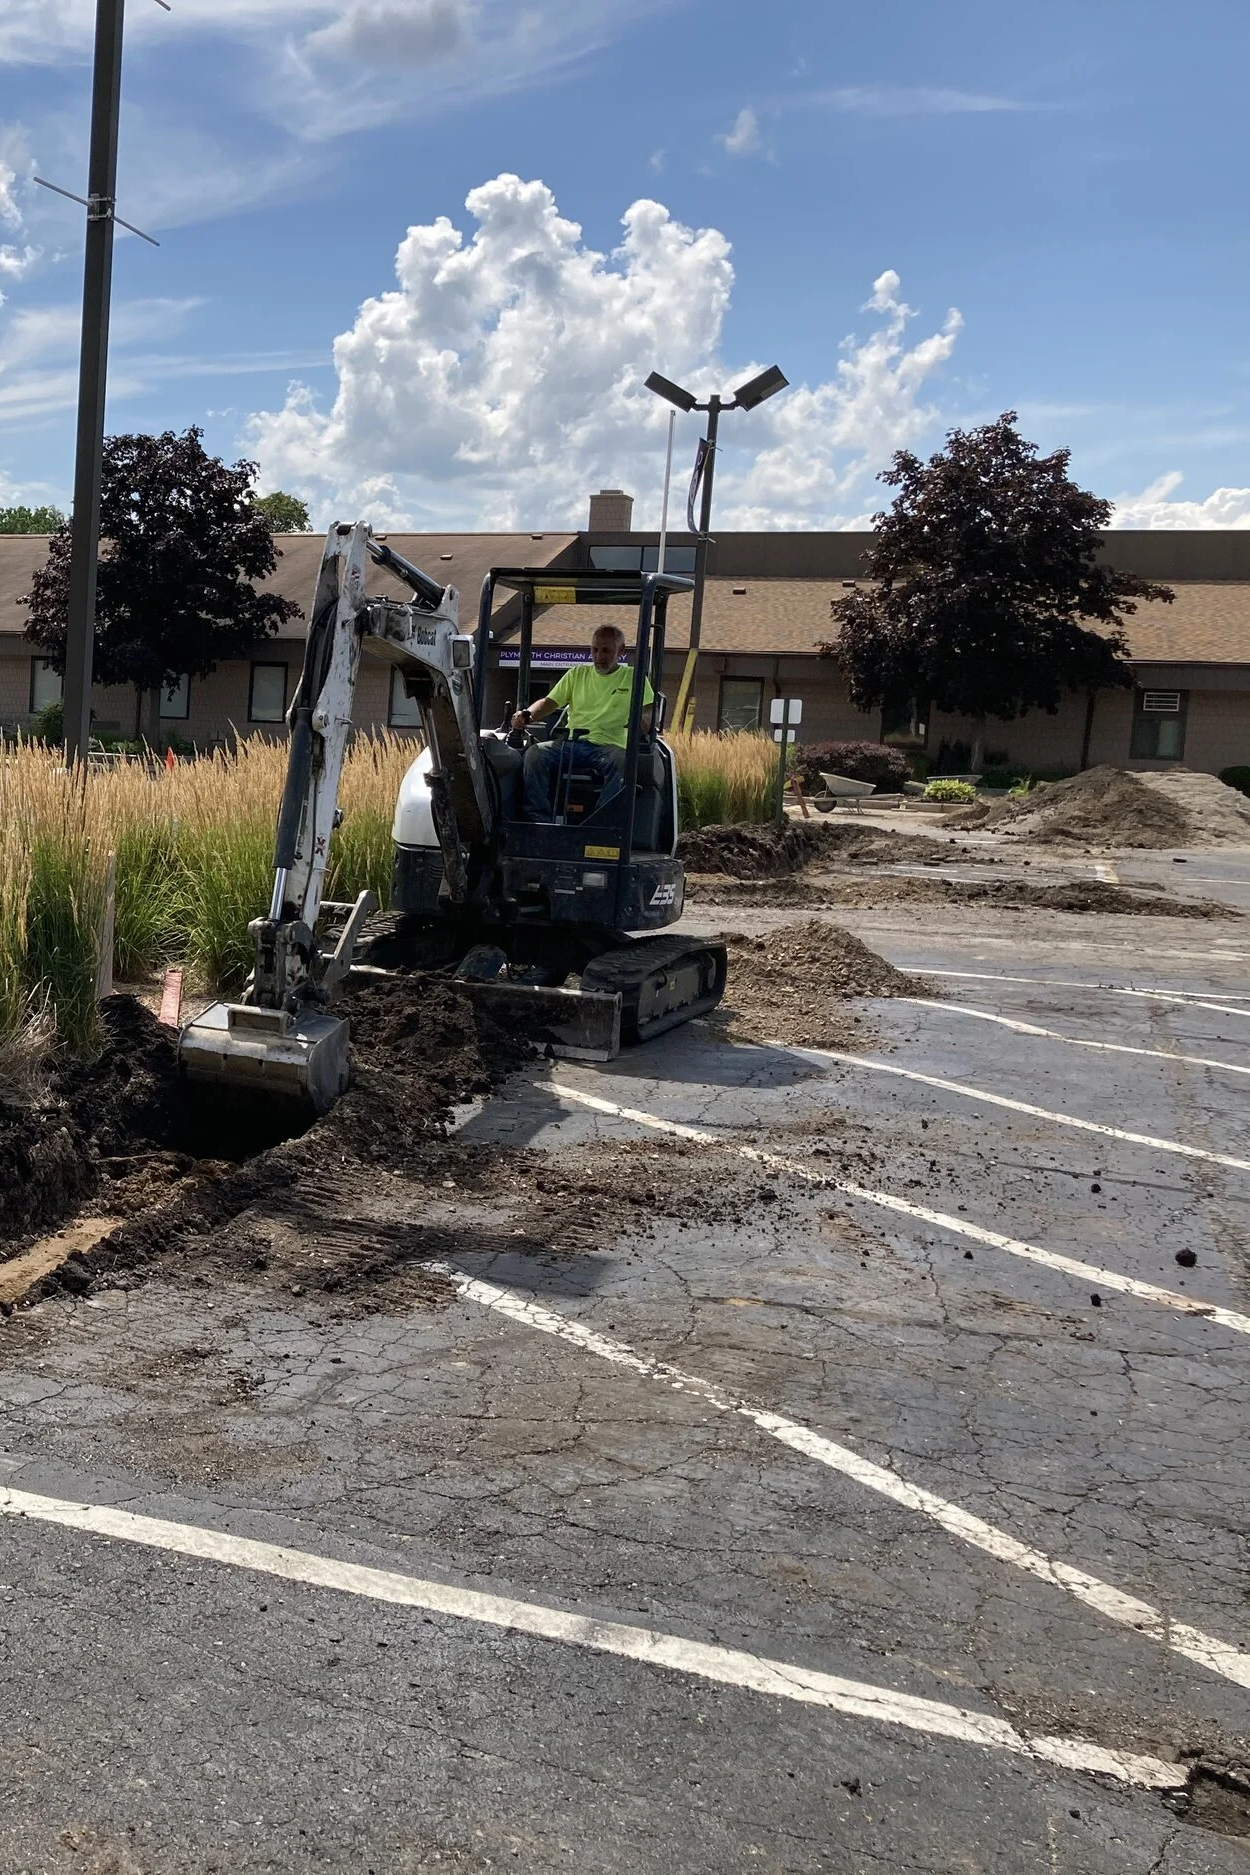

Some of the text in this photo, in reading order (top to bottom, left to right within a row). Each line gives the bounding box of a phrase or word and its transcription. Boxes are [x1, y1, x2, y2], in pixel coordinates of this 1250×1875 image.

[417, 627, 437, 646] Bobcat
[501, 651, 541, 659] PLYMTH
[544, 652, 585, 660] CHRISTIAN
[649, 884, 676, 905] E35
